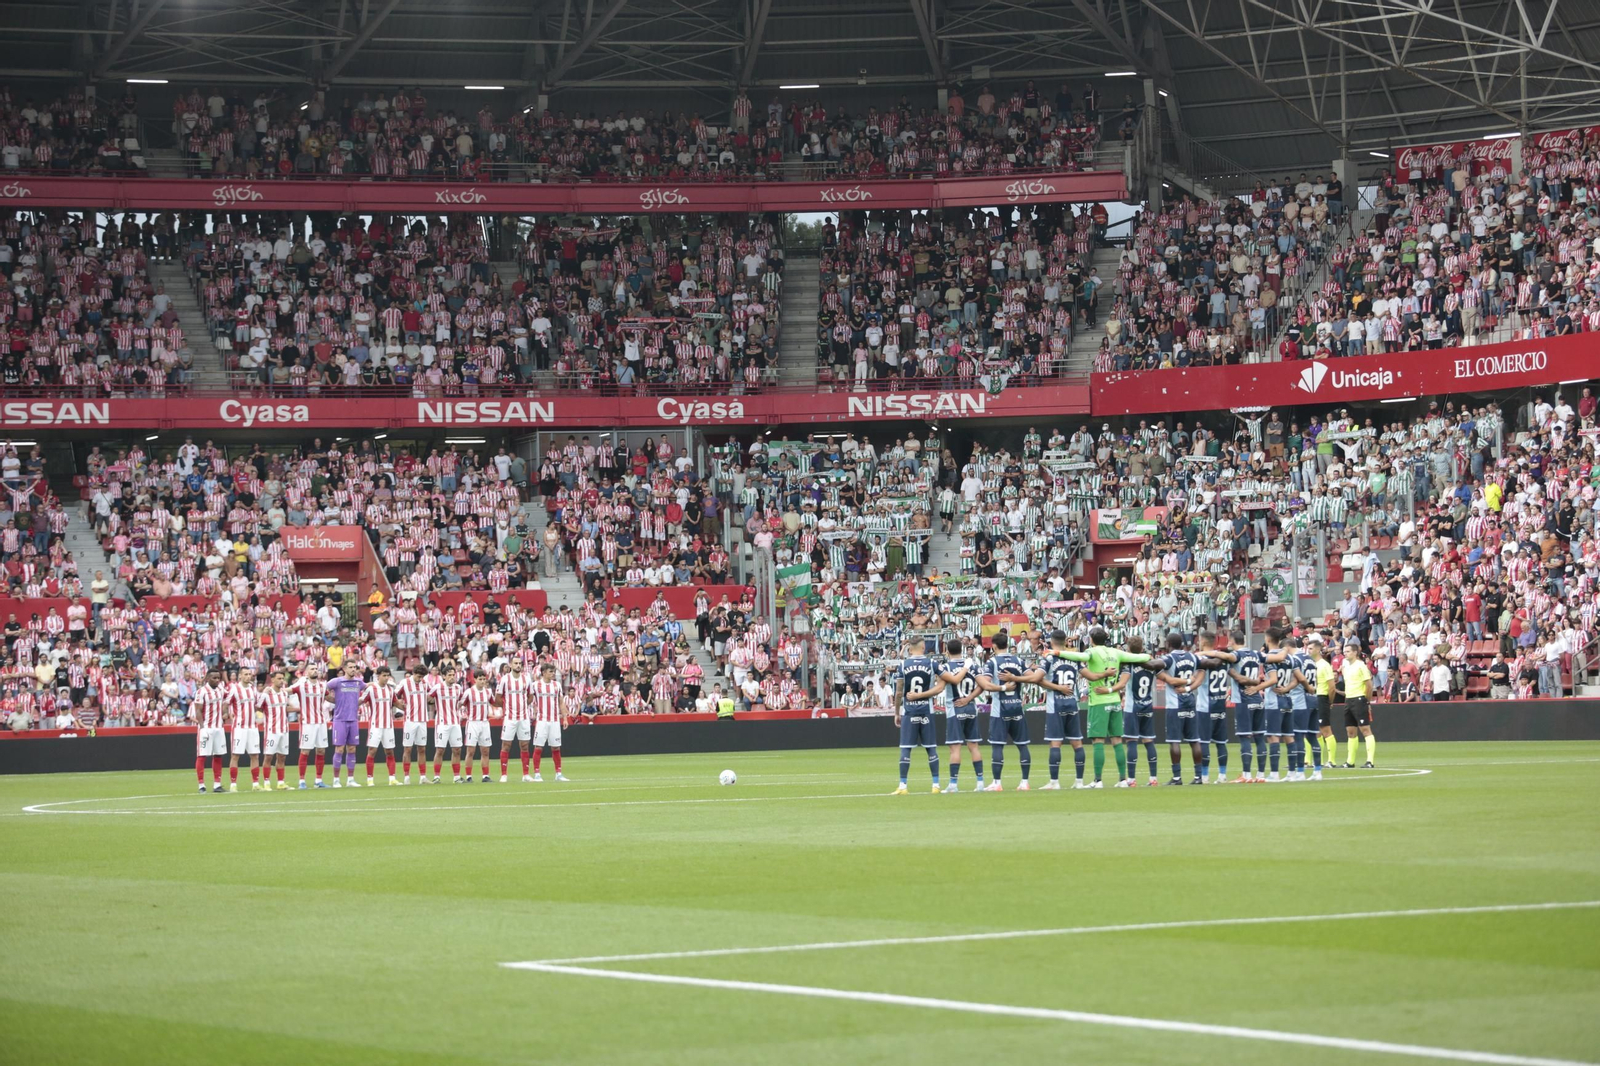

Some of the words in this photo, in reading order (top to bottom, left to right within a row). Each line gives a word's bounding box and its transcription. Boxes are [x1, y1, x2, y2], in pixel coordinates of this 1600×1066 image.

[0, 181, 32, 197] ón
[1454, 359, 1475, 378] EL
[1475, 351, 1547, 377] COMERCIO
[1331, 367, 1393, 390] Unicaja
[219, 399, 309, 426] Cyasa
[417, 401, 554, 423] NISSAN
[656, 397, 744, 424] Cyasa
[848, 393, 986, 417] NISSAN
[287, 531, 331, 549] Halcón
[331, 539, 355, 550] viajes
[1056, 670, 1075, 691] 16
[1209, 669, 1228, 693] 22
[1244, 666, 1259, 681] 14
[910, 676, 924, 695] 6
[957, 677, 974, 698] 10
[1138, 675, 1150, 698] 8
